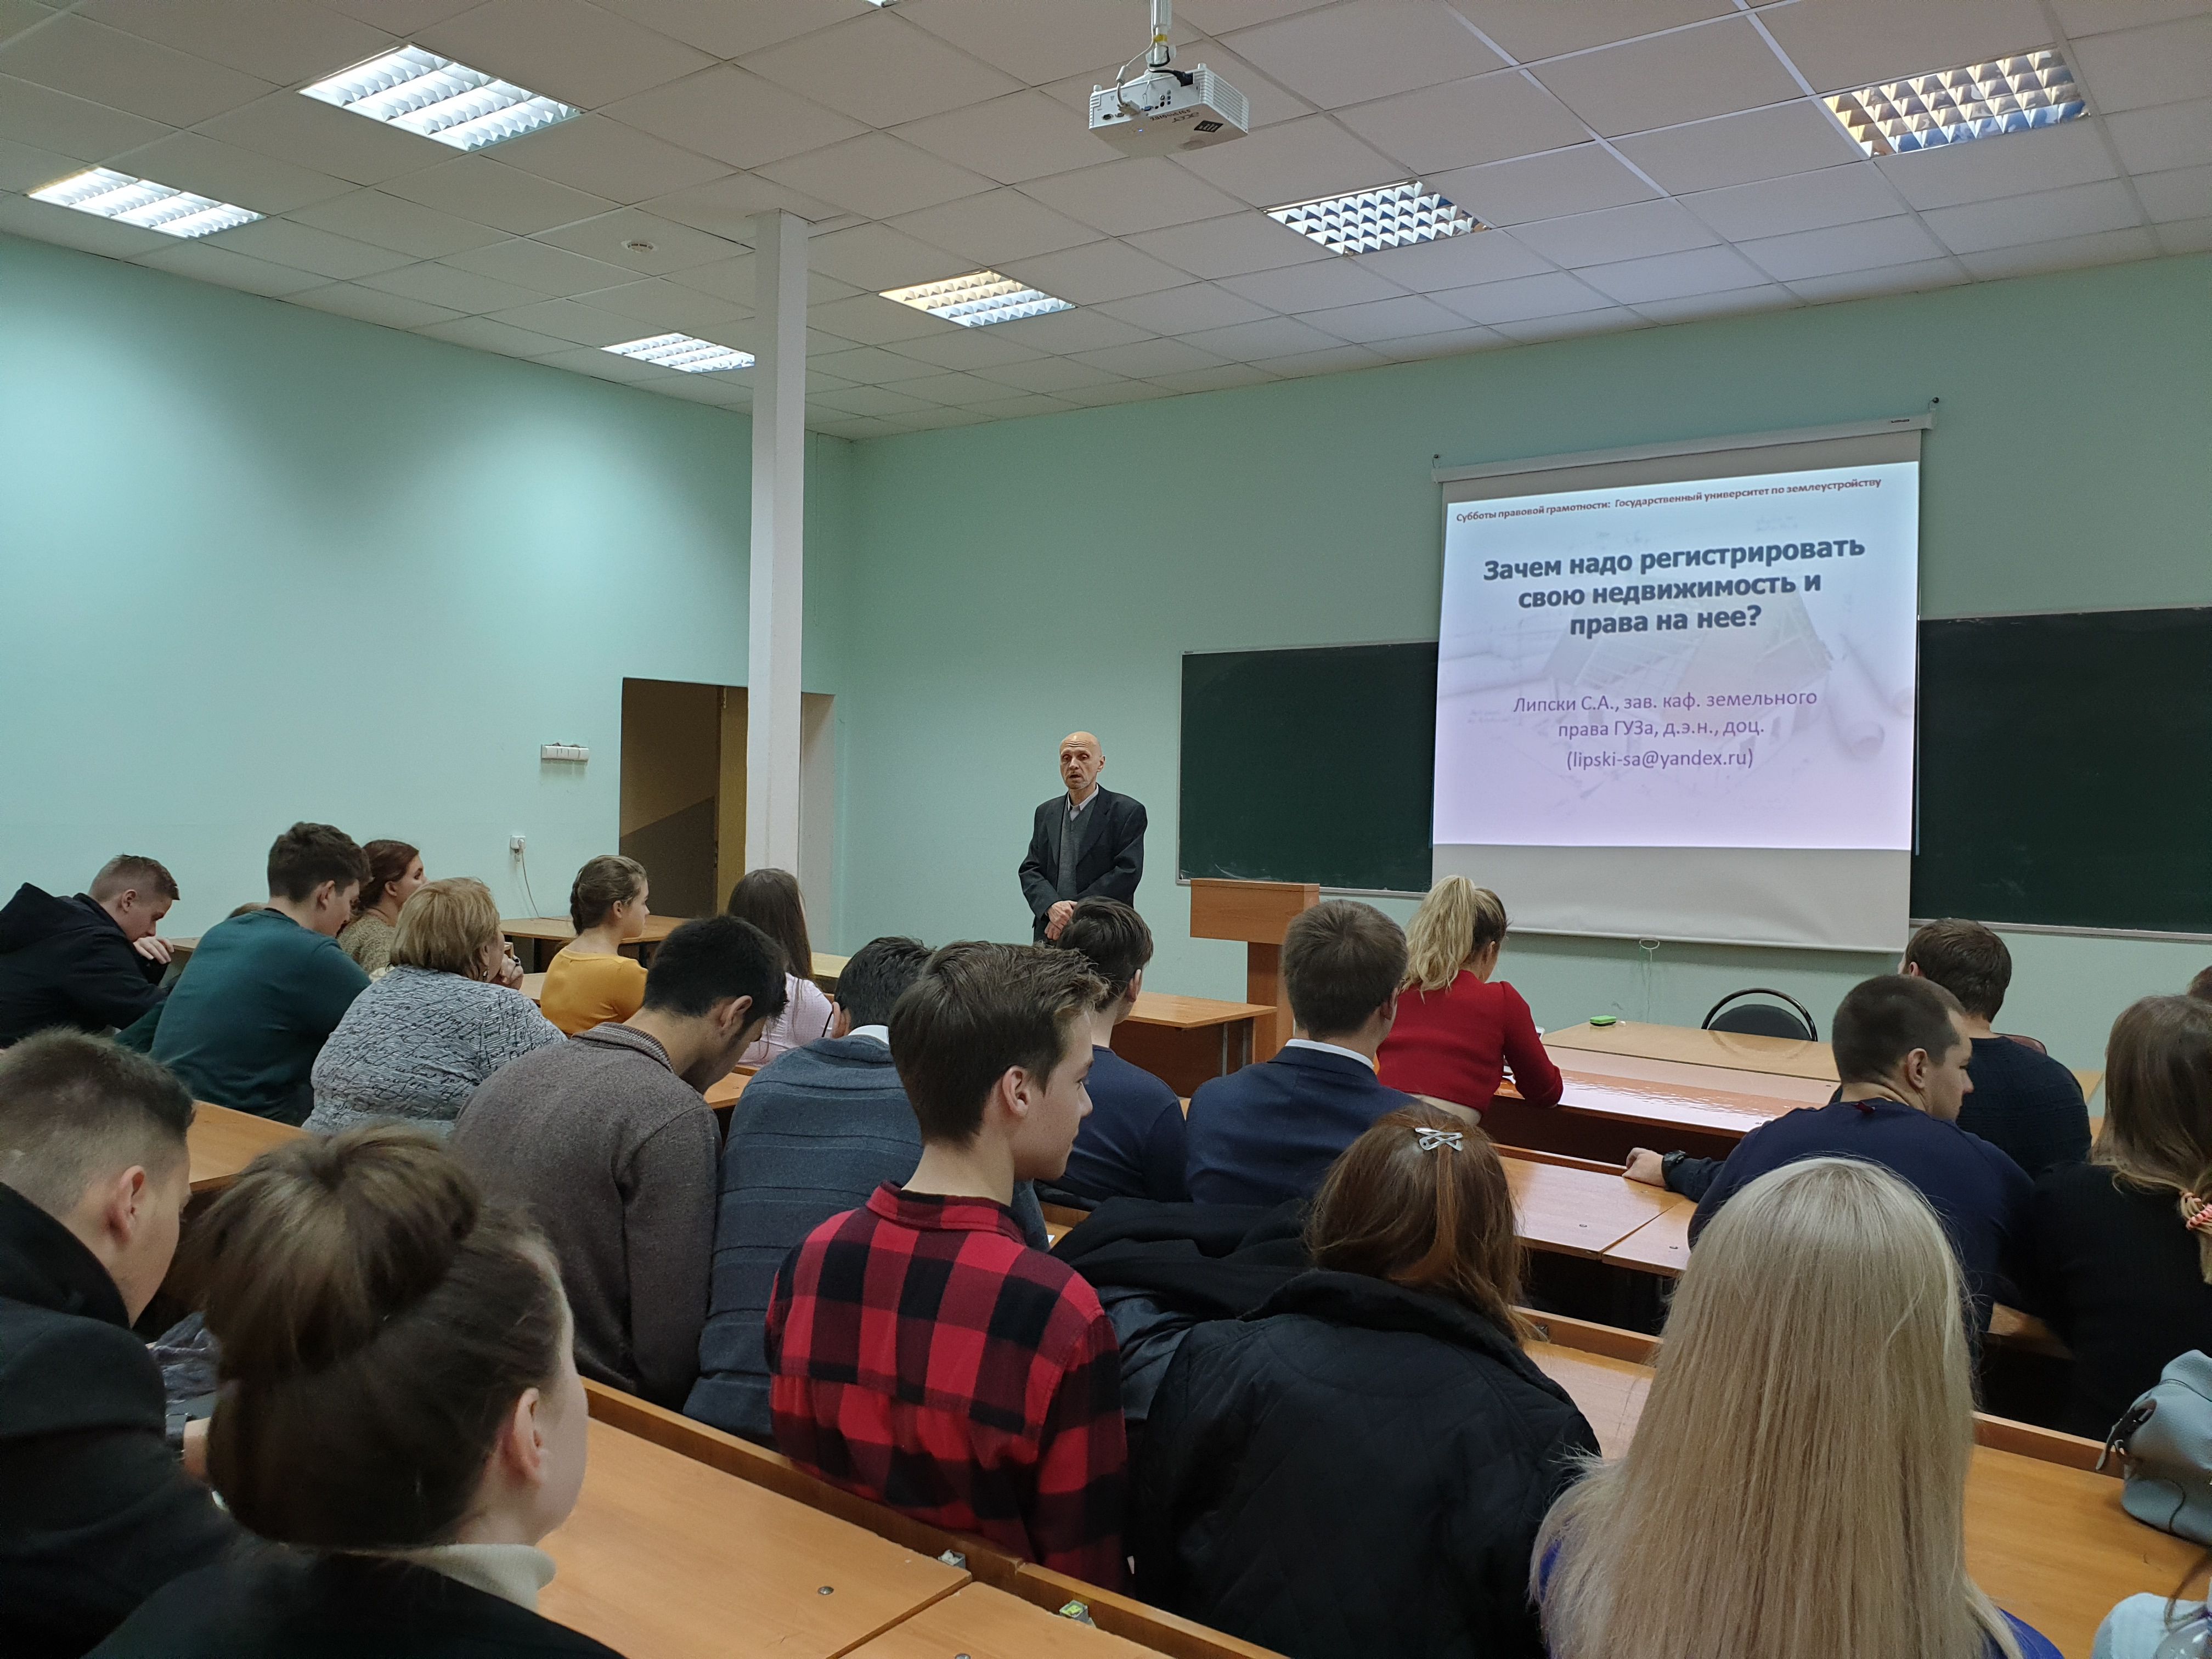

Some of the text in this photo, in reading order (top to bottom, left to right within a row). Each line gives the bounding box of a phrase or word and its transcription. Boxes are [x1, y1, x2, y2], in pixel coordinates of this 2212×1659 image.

[1457, 478, 1882, 524] Субботы правовой грамотности: Государственный университет по землеустройству
[1483, 539, 1865, 581] Зачем надо регистрировать
[1518, 574, 1821, 608] свою недвижимость и
[1570, 604, 1762, 640] права на нее?
[1513, 692, 1817, 713] Липски С.А., зав. каф. земельного
[1558, 720, 1764, 740] права ГУЗа, д.э.н., доц.
[1567, 748, 1753, 771] (lipski-sa@yandex.ru)
